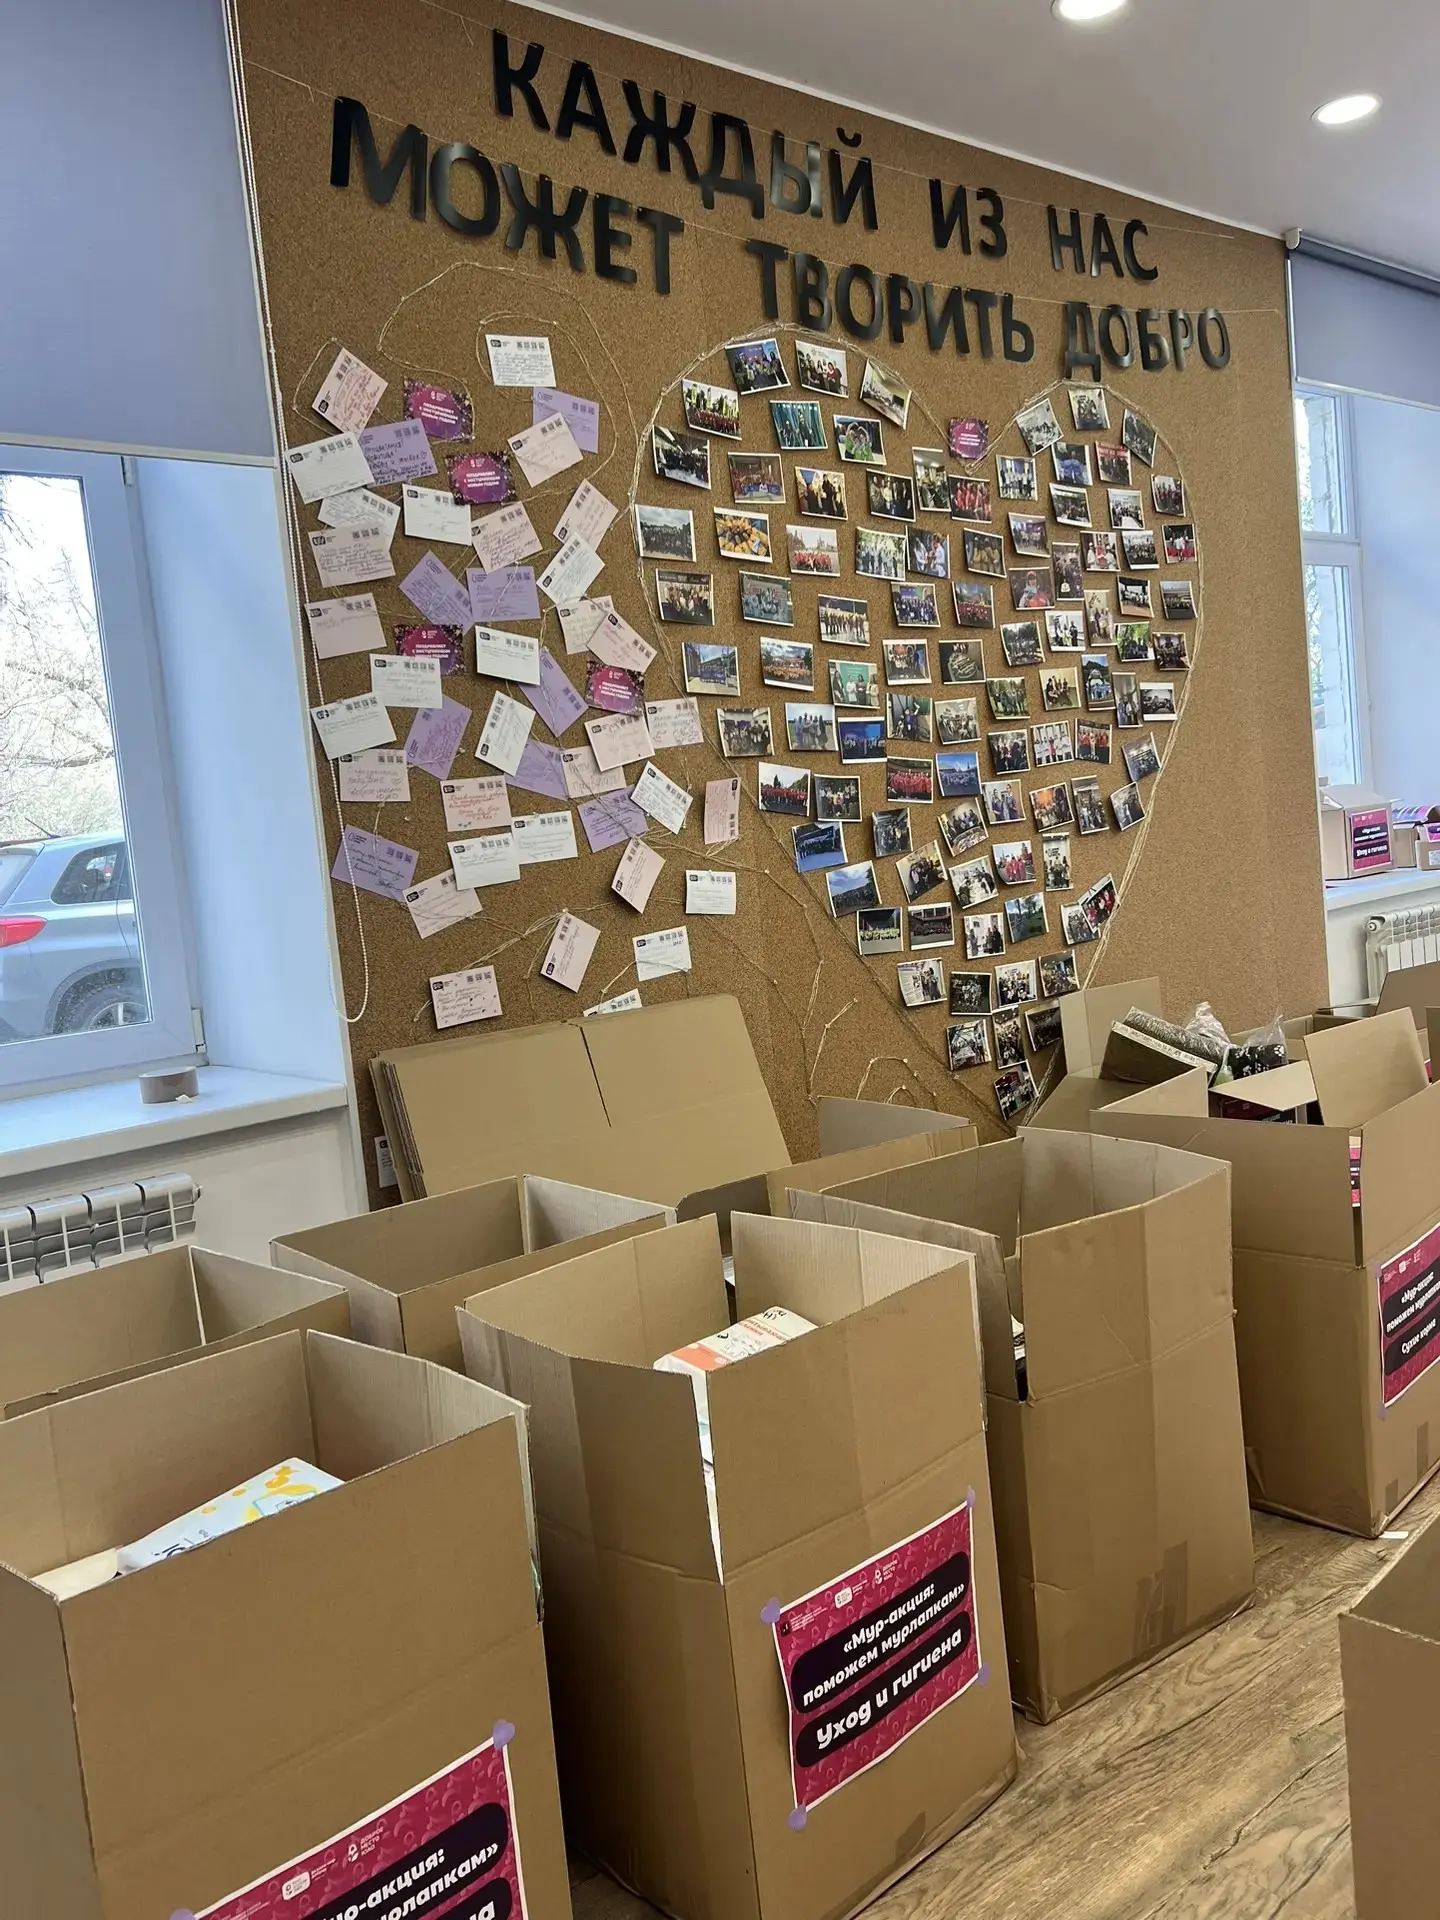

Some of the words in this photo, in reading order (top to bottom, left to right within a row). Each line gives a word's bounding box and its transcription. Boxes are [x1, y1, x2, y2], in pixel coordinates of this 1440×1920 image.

[493, 28, 879, 231] КАЖДЫЙ
[929, 178, 1008, 258] ИЗ
[1046, 204, 1159, 281] НАС
[329, 95, 685, 296] МОЖЕТ
[745, 238, 1035, 363] ТВОРИТЬ
[1063, 301, 1231, 382] ДОБРО
[1401, 1334, 1420, 1354] Сухие
[802, 1646, 878, 1707] поможем
[881, 1582, 965, 1656] мурлапкам»
[843, 1582, 935, 1653] «Мур-акция:
[816, 1701, 872, 1750] Уход
[876, 1687, 888, 1709] и
[892, 1628, 963, 1698] гигиена
